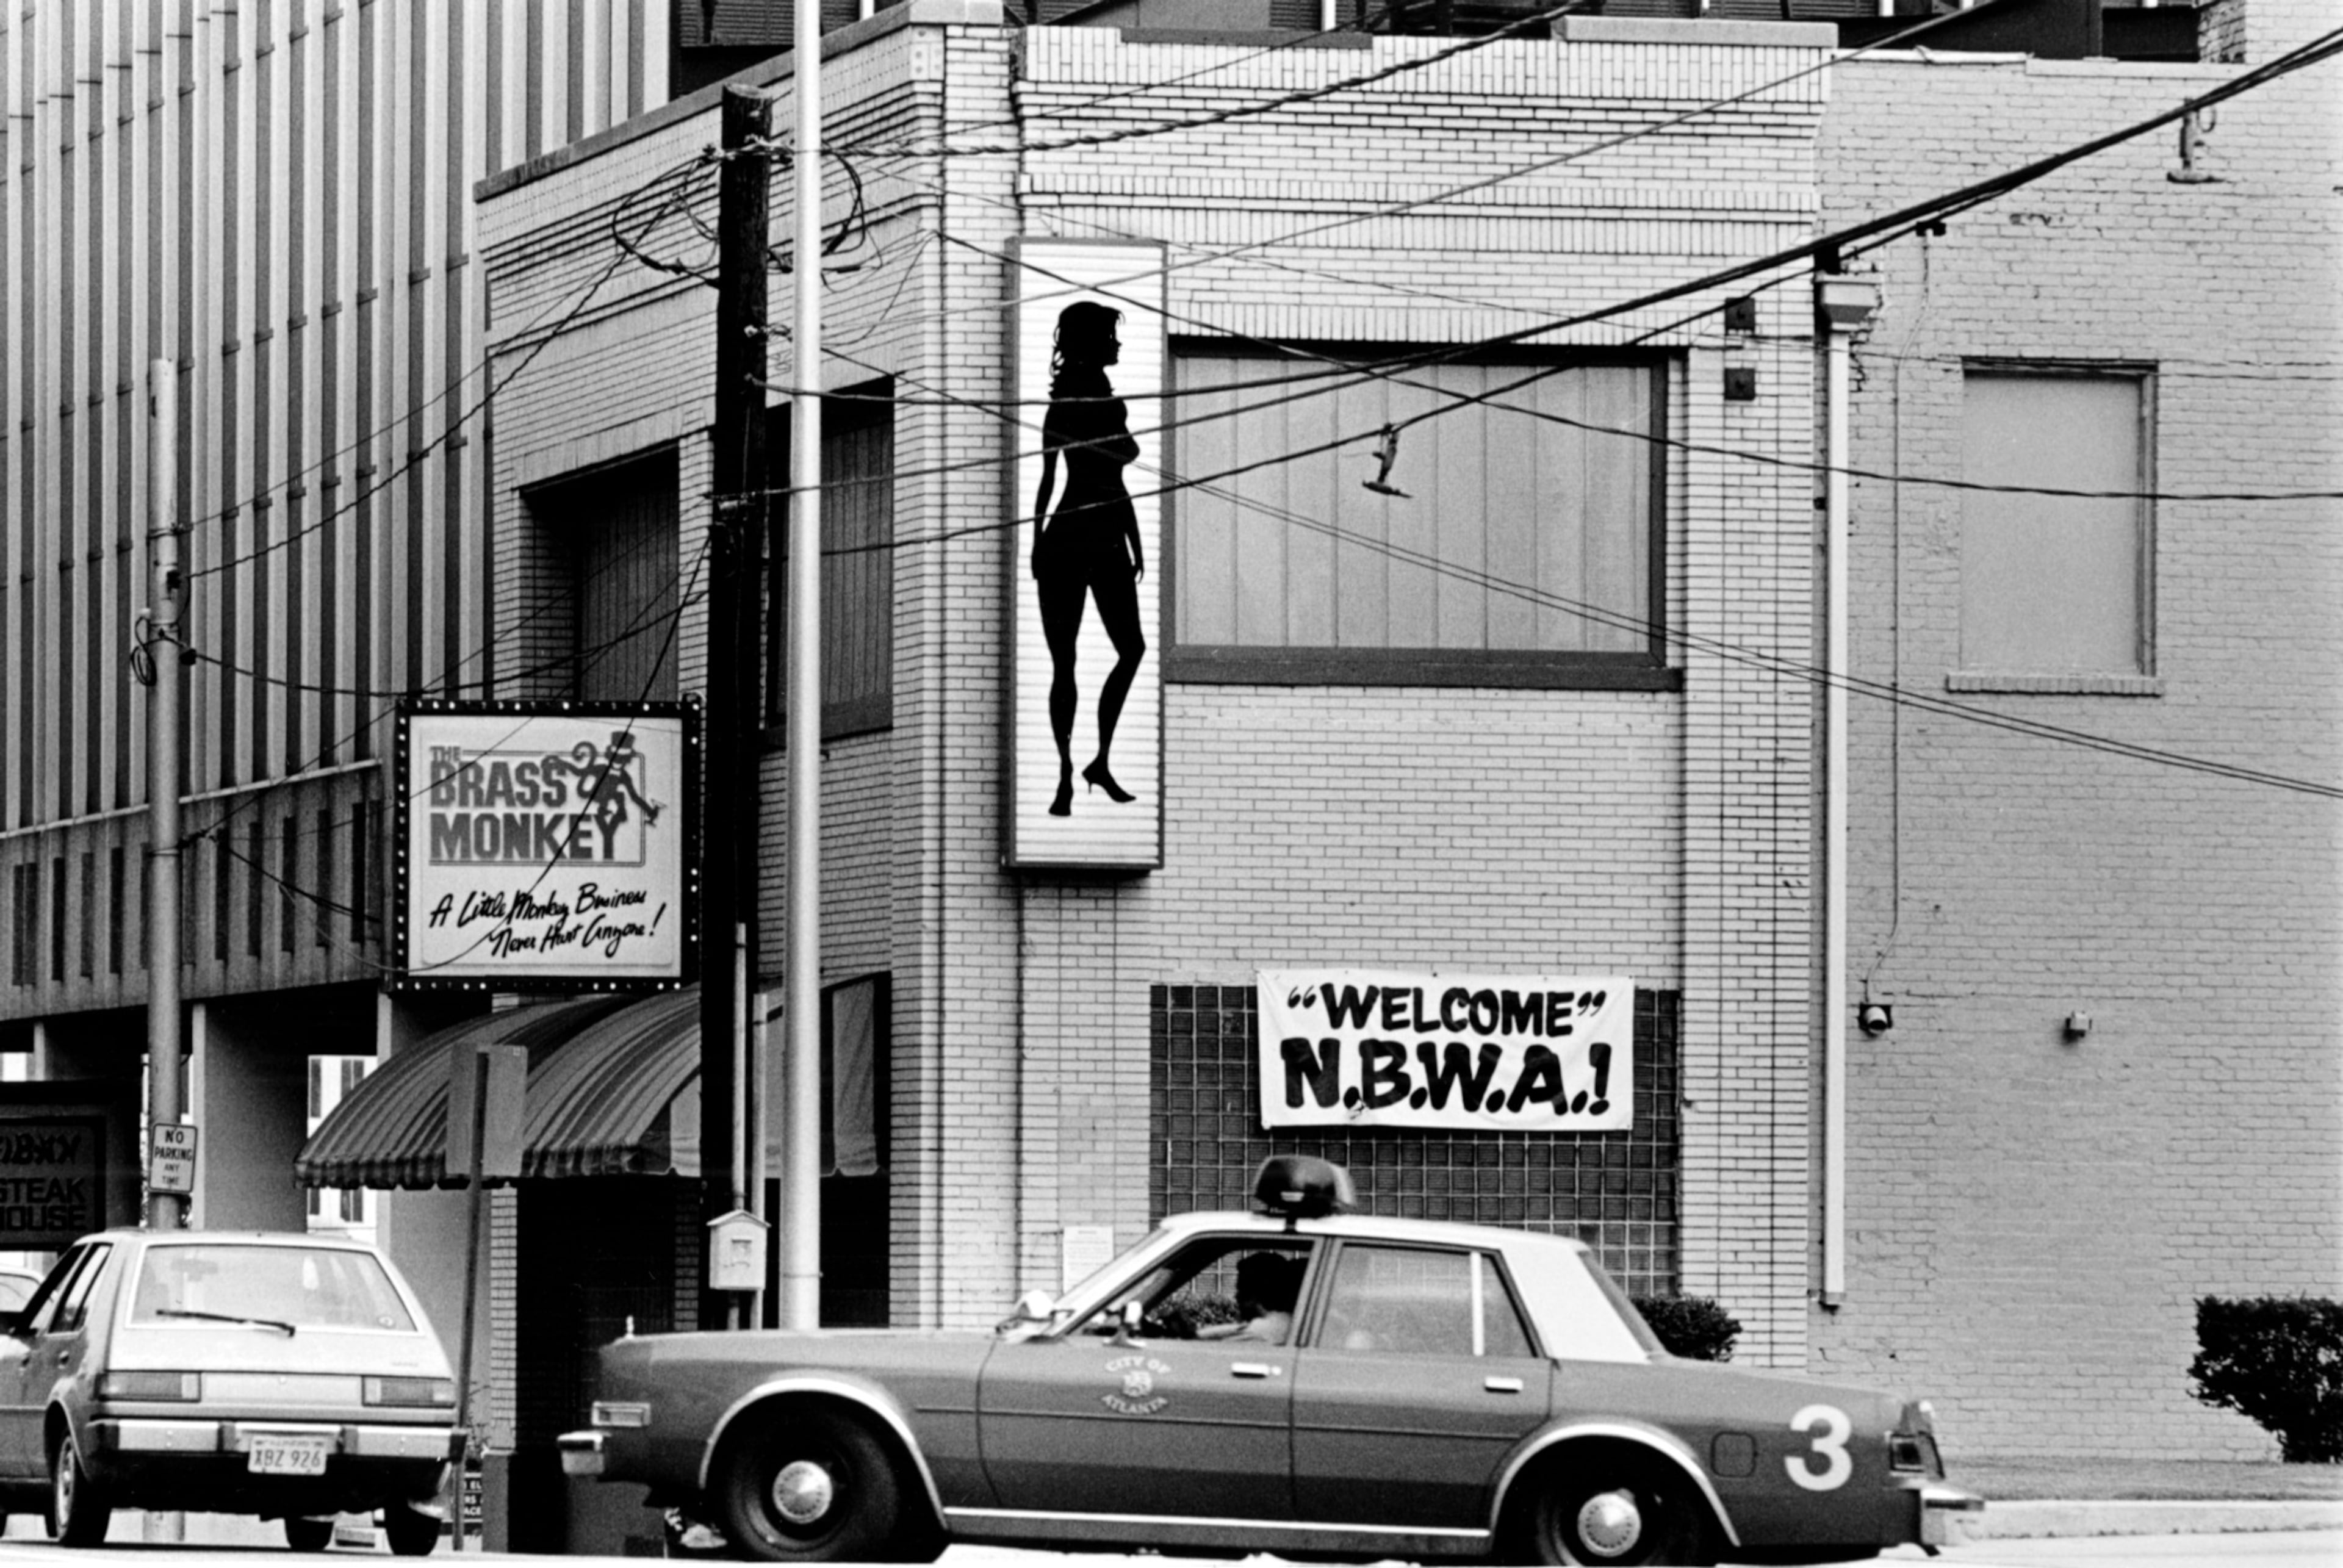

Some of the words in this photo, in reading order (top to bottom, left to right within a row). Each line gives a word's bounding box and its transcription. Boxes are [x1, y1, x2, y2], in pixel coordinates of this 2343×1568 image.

[430, 746, 461, 761] THE
[430, 762, 567, 807] BRASS
[430, 813, 624, 860] MONKEY
[429, 894, 453, 927] A
[457, 891, 506, 927] Little
[506, 890, 569, 932] Monkey
[575, 882, 647, 914] Business
[488, 927, 536, 958] Never
[539, 923, 583, 953] Hurt
[1281, 1037, 1612, 1115] N.B.W.A.!
[165, 1130, 184, 1143] NO
[154, 1146, 193, 1162] PARKING
[162, 1176, 180, 1185] TIME
[0, 1206, 87, 1231] OUSE
[1105, 1356, 1145, 1372] CITY
[1101, 1394, 1168, 1414] ATLANTA
[291, 1450, 321, 1467] 926
[1784, 1404, 1852, 1491] 3
